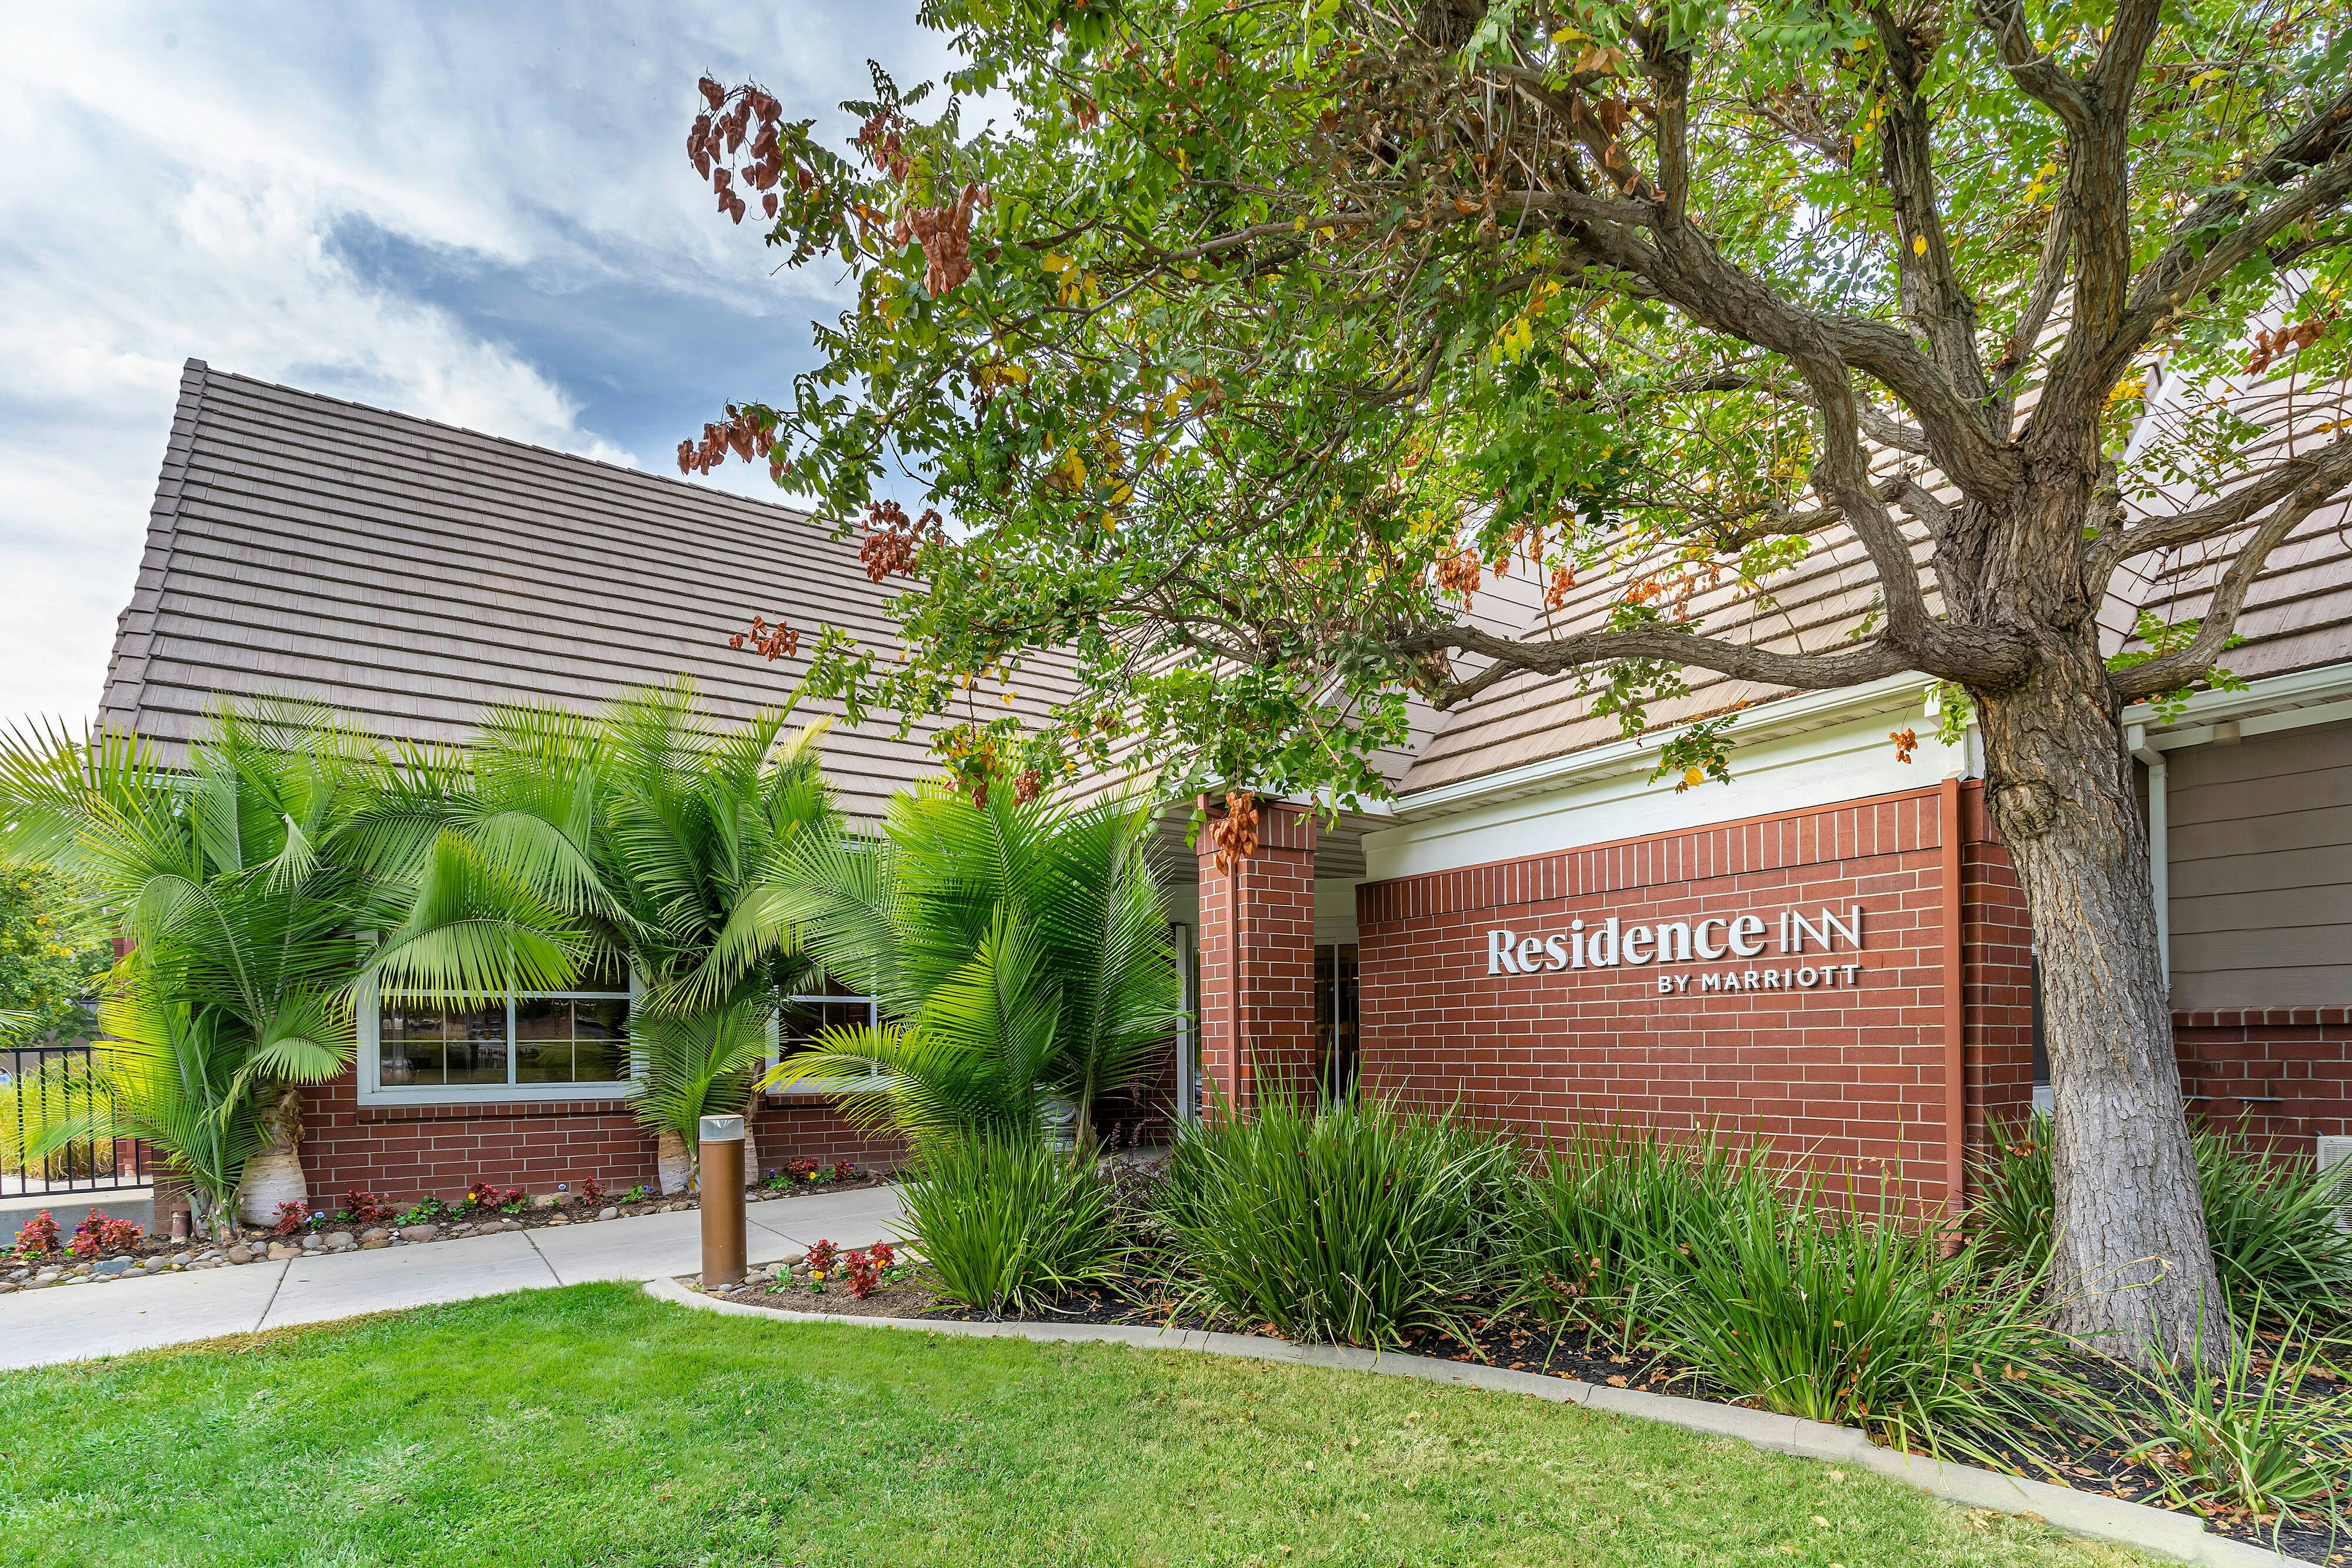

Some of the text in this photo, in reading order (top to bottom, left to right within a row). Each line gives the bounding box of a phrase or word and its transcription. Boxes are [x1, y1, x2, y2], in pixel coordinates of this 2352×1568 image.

[1486, 905, 1861, 975] Residence INN
[1658, 964, 1860, 994] BY MARRIOTT
